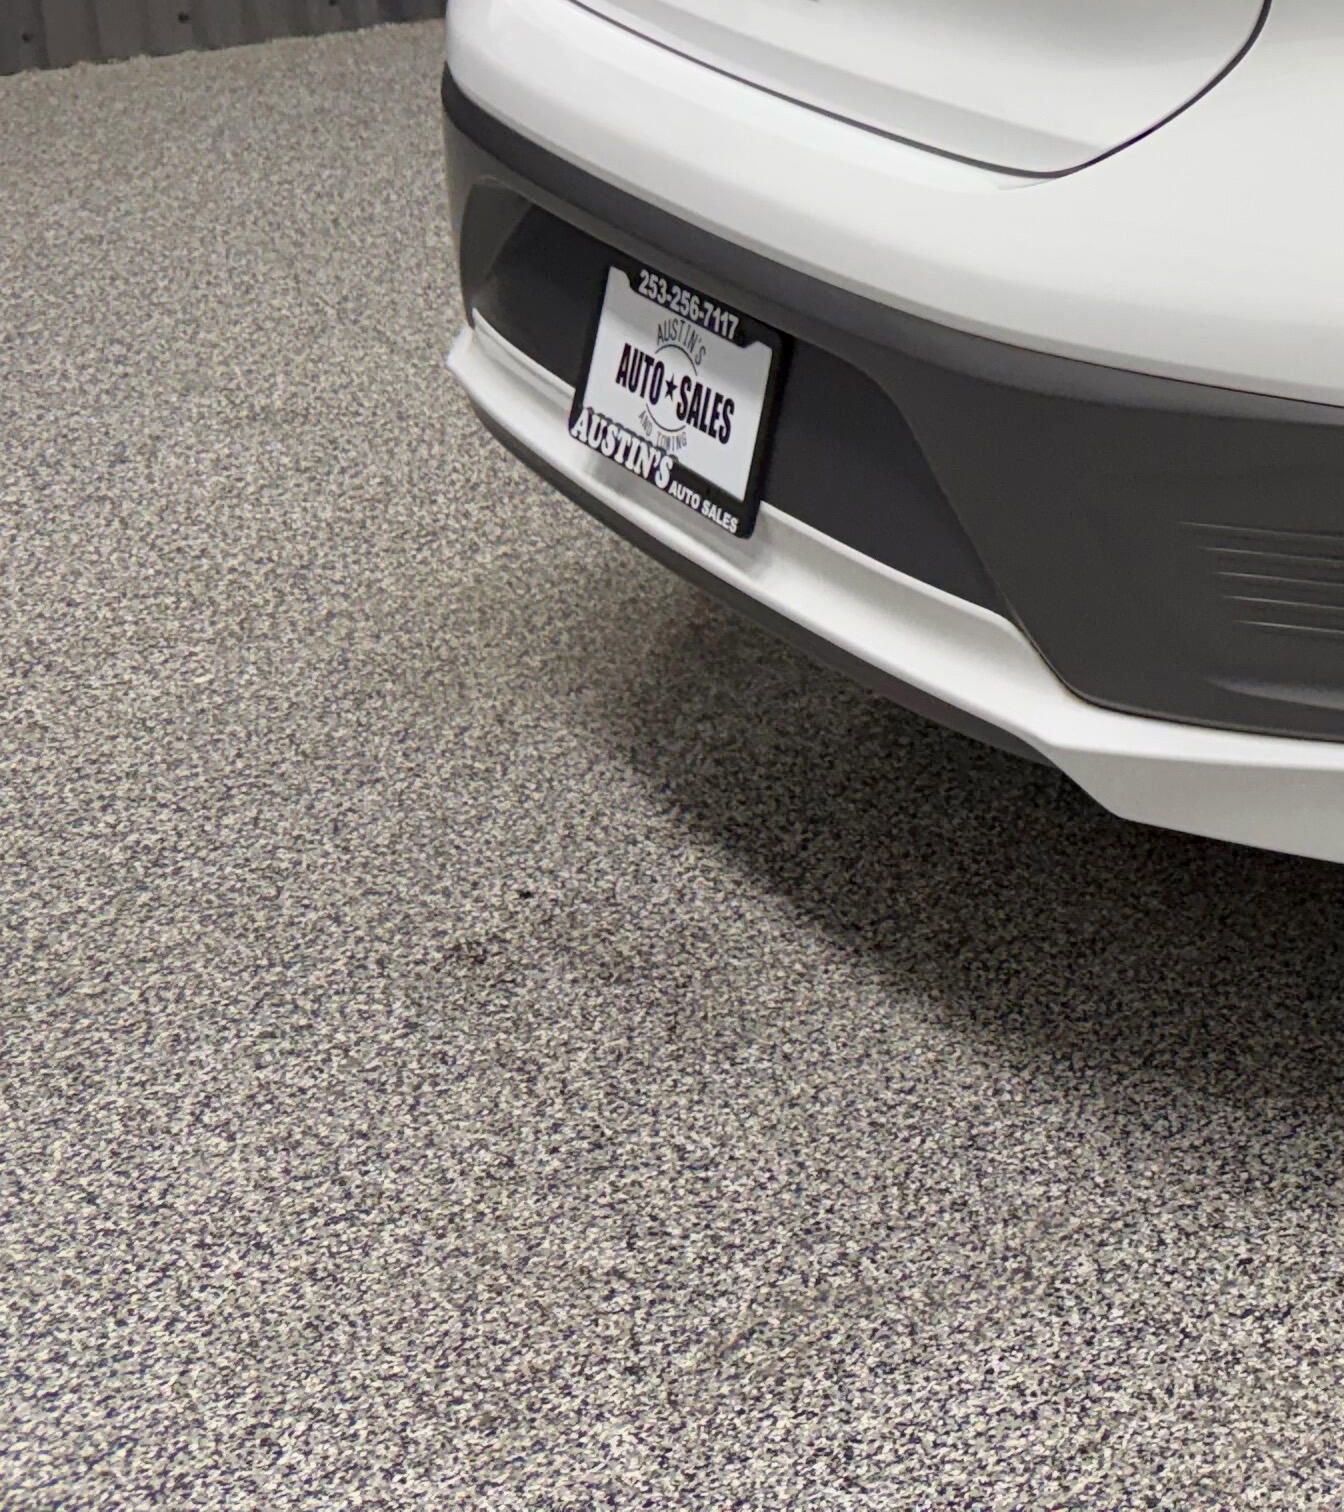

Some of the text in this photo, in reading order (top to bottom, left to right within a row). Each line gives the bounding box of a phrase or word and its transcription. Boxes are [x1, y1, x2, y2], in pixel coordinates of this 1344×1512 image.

[638, 269, 740, 340] 253-256-7117
[656, 317, 706, 366] AUSTIN'S
[615, 342, 735, 445] AUTO SALES
[570, 408, 674, 488] AUSTIN'S
[668, 482, 739, 535] AUTO SALES
